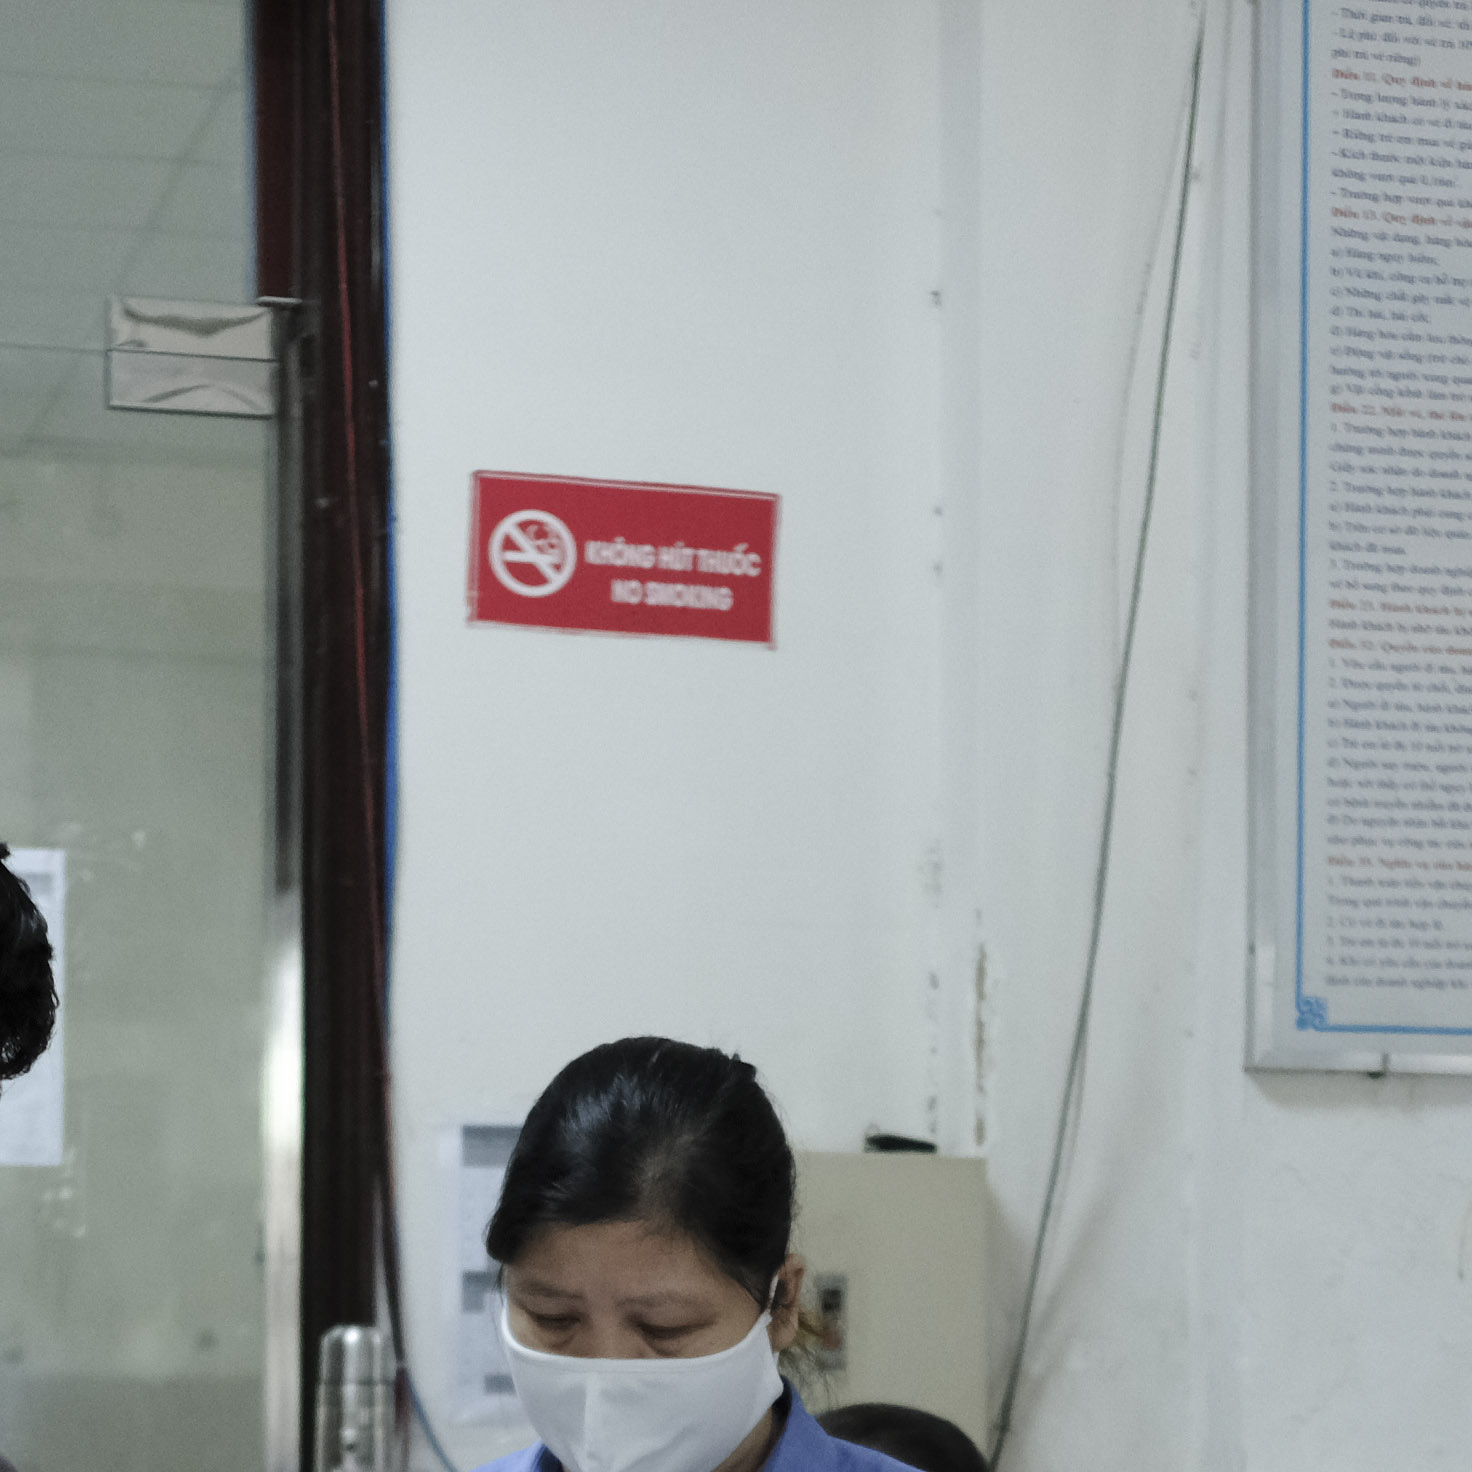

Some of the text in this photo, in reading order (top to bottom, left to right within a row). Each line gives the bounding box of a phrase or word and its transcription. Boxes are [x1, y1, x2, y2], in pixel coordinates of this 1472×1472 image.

[584, 535, 762, 576] KHÔNG HÚT THUỐC
[610, 578, 734, 611] NO SMOKING
